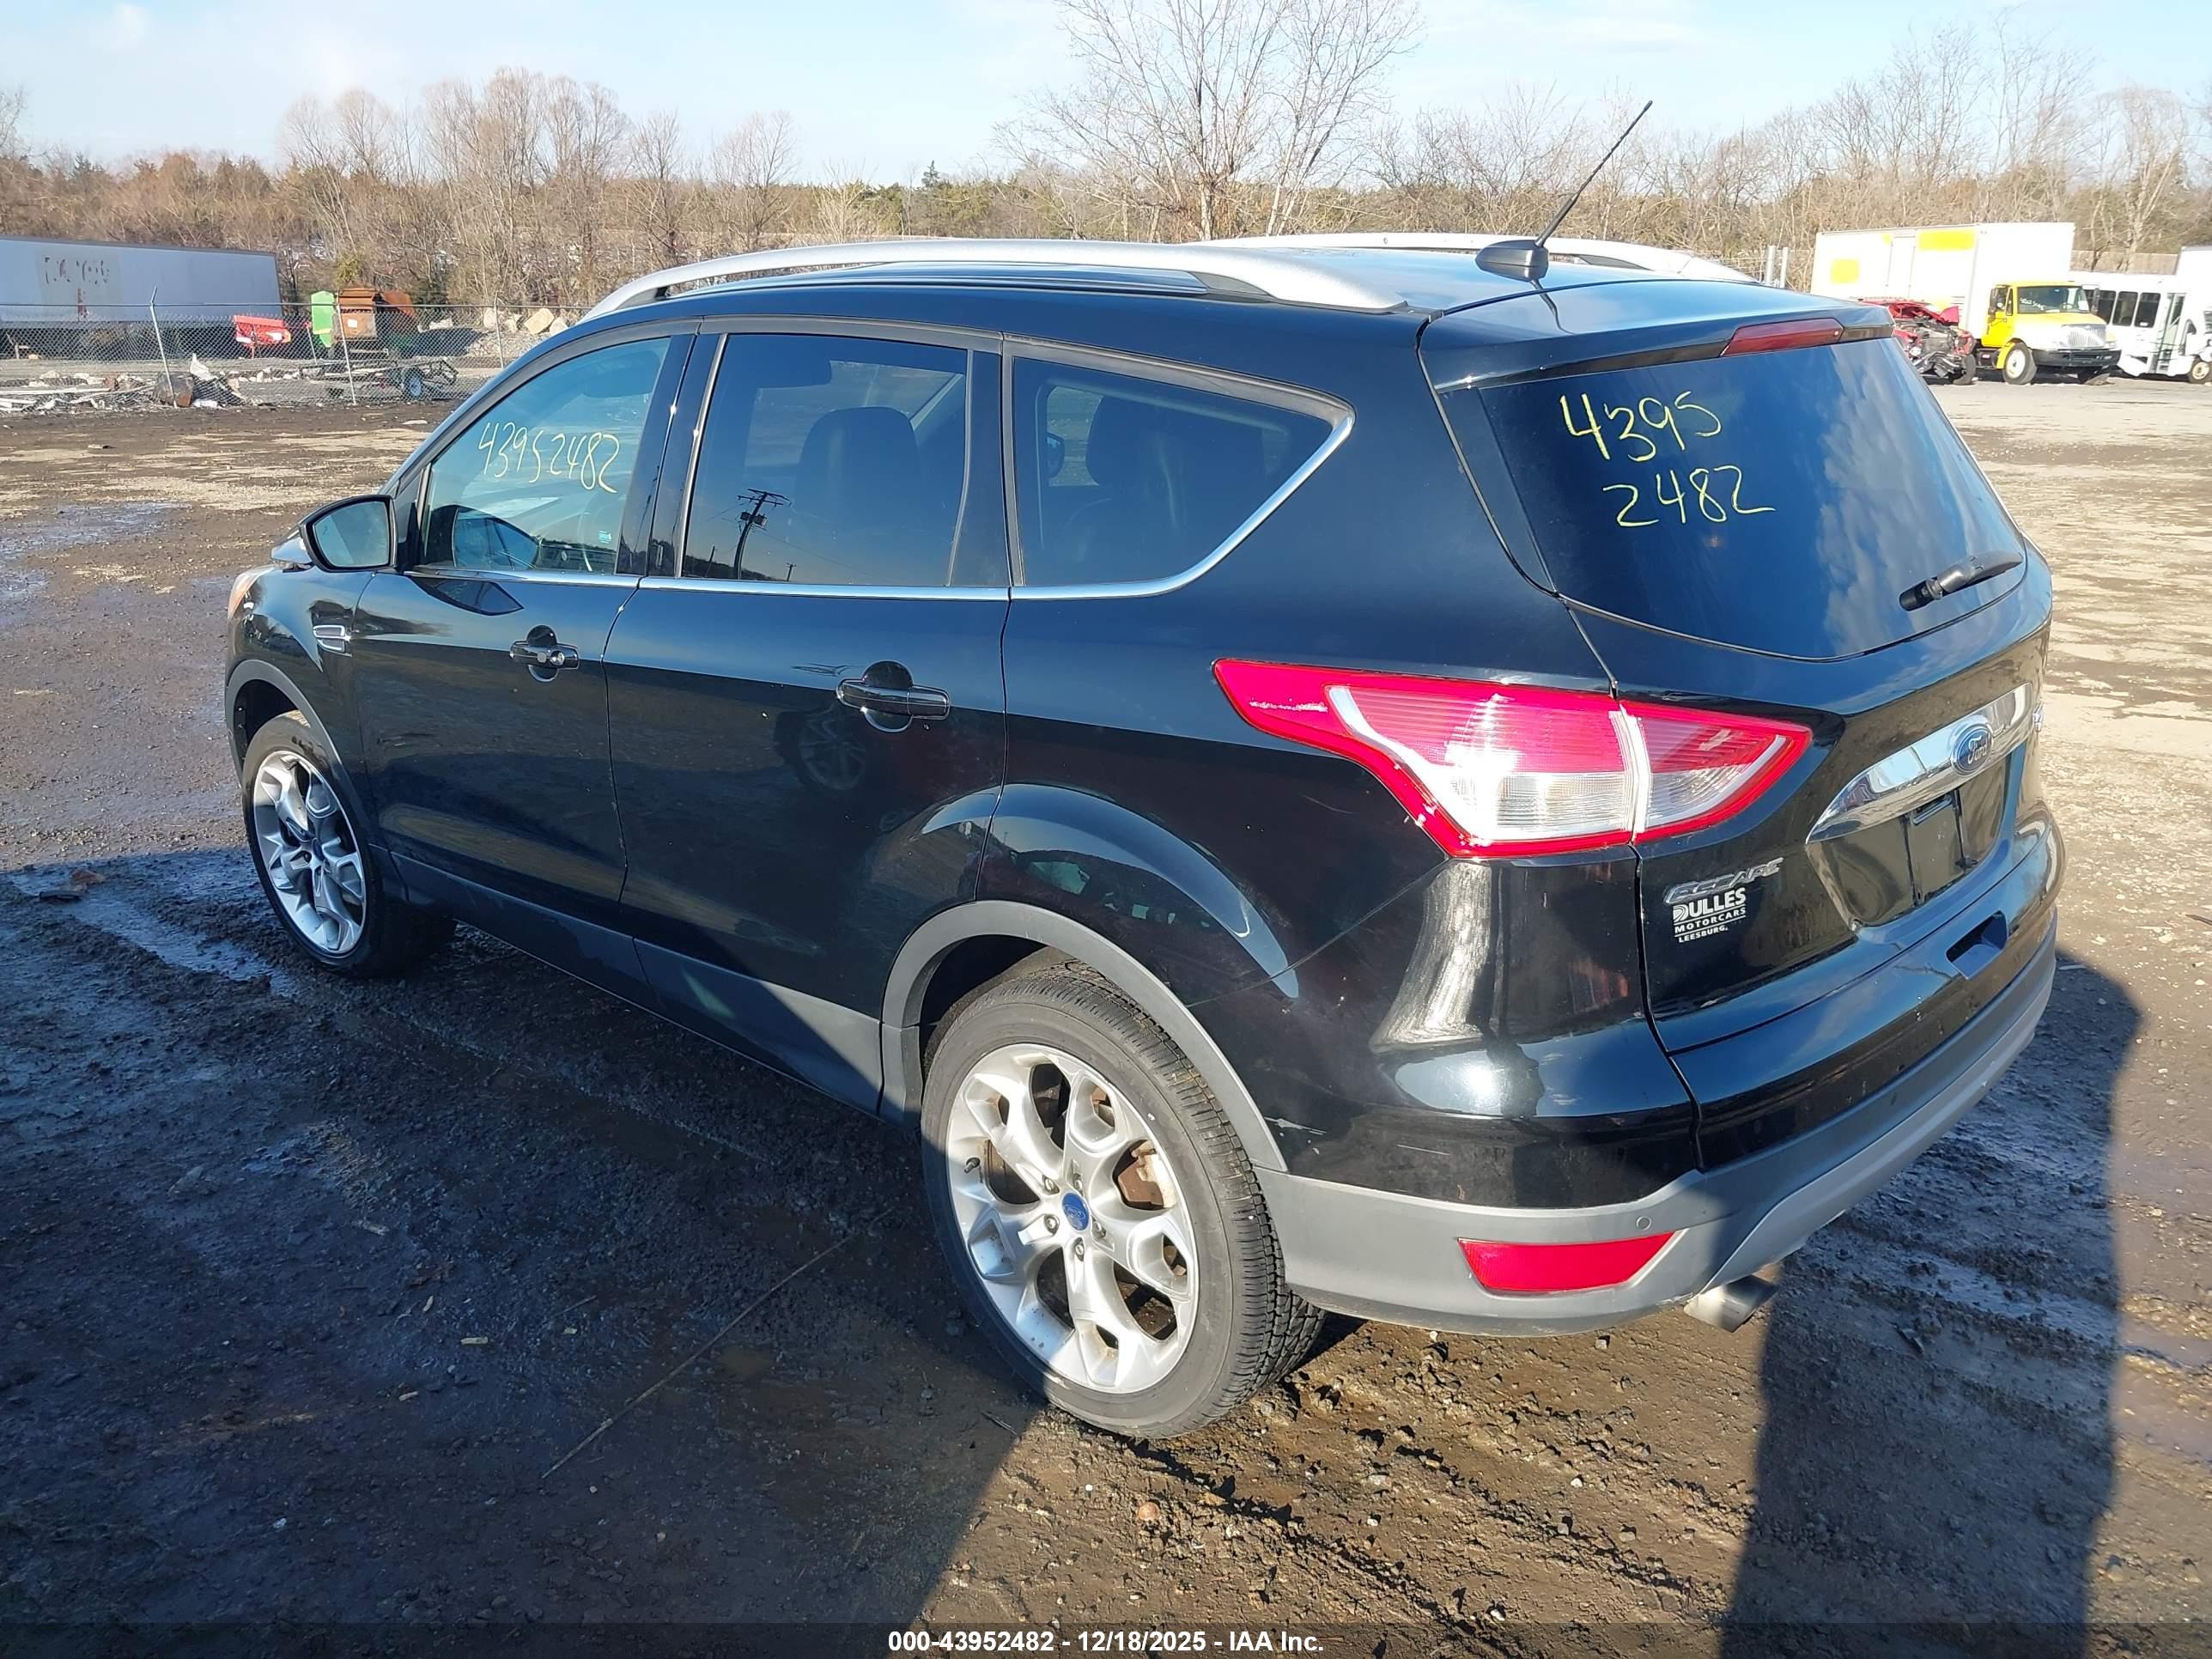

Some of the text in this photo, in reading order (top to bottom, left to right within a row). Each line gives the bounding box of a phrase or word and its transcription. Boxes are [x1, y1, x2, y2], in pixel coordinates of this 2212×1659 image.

[1559, 391, 1721, 461] 4395
[478, 422, 619, 494] 43952482
[1603, 465, 1776, 526] 2482
[1968, 735, 1988, 764] Ford
[1673, 887, 1746, 922] DULLES
[1674, 907, 1746, 934] MOTORCARS
